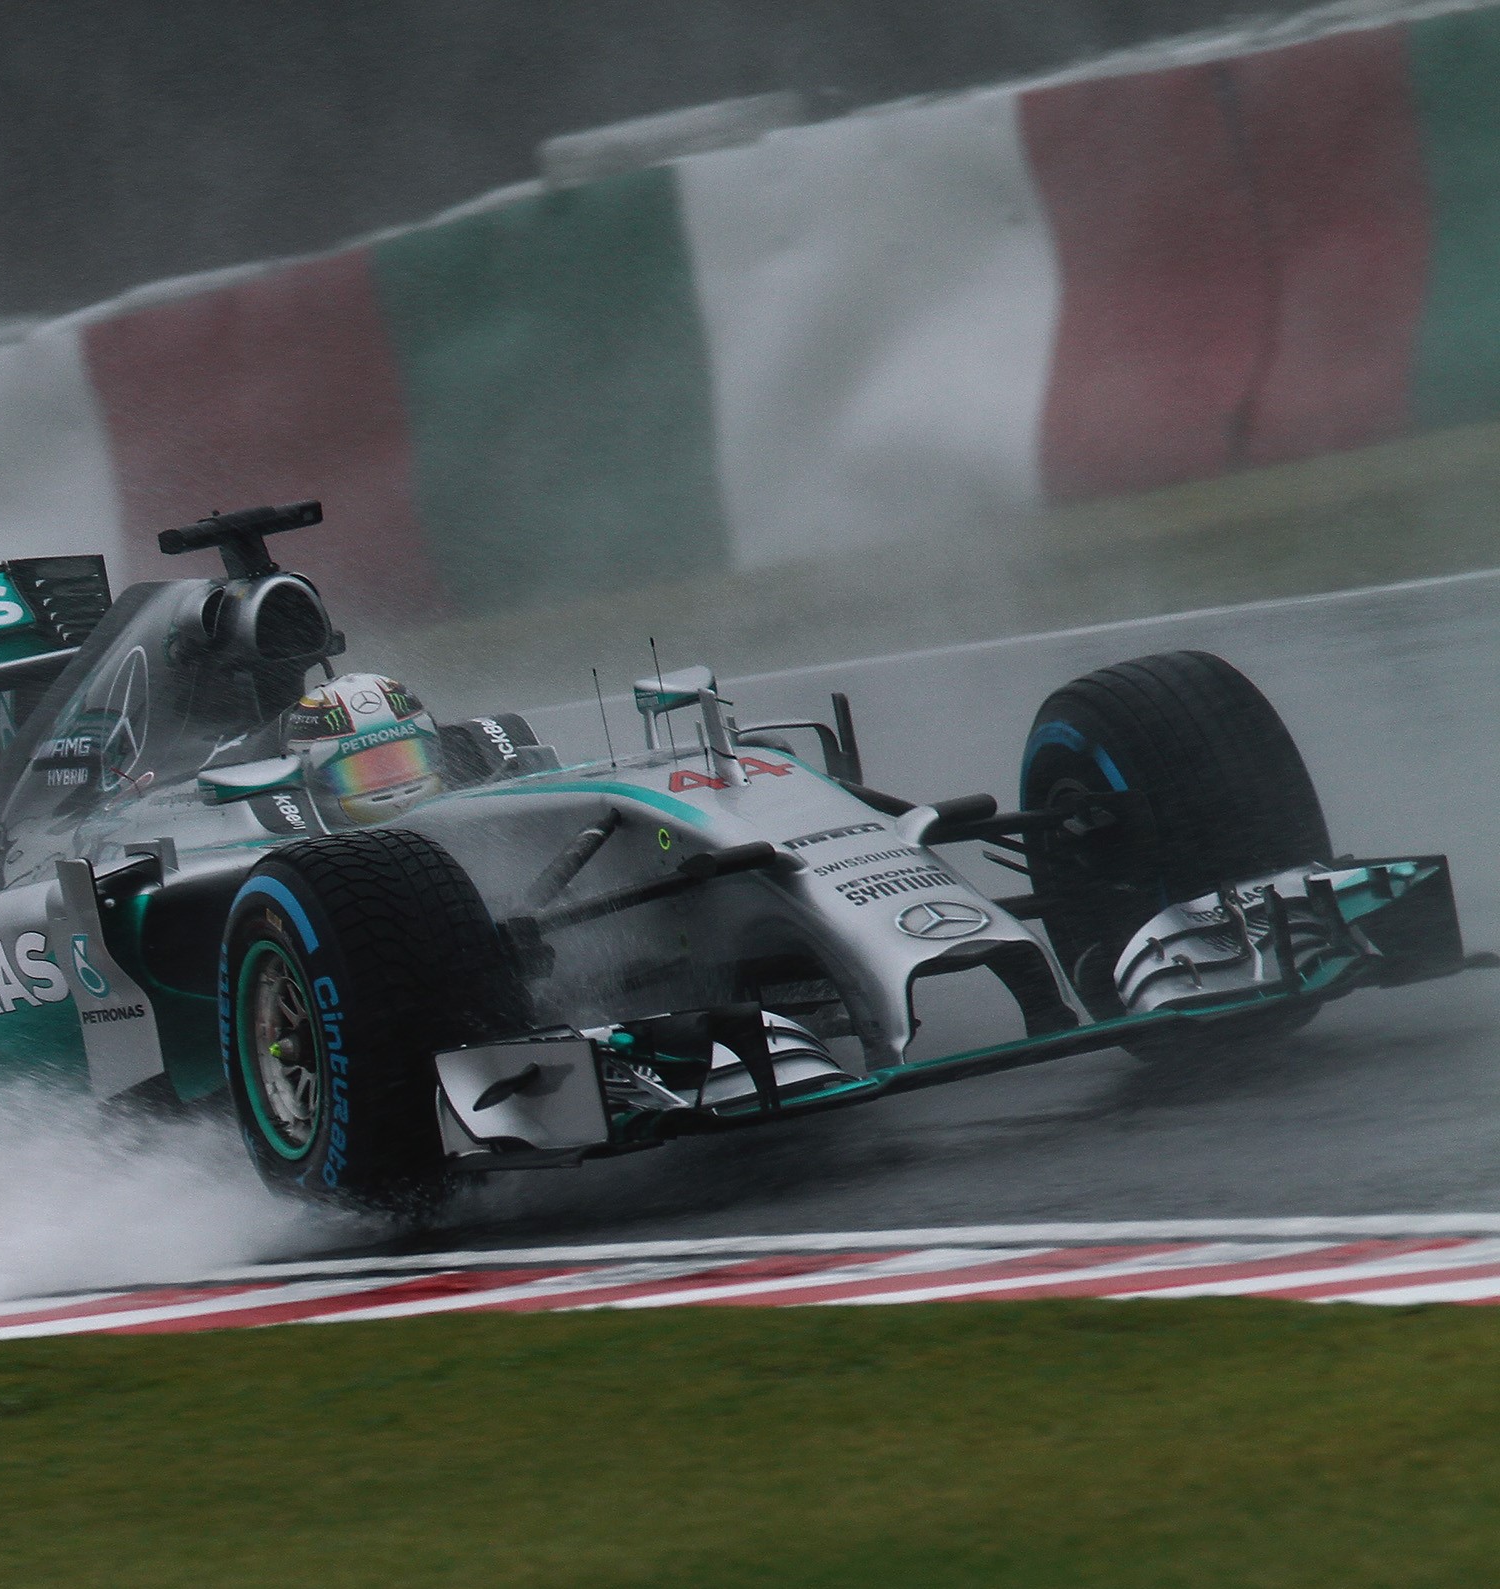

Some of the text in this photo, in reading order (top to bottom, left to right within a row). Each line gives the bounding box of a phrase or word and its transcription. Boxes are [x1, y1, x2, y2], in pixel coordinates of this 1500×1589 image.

[51, 736, 92, 757] AMG
[341, 723, 417, 754] PETRONAS
[47, 767, 89, 786] HYBRID
[668, 756, 797, 793] 44
[835, 864, 940, 893] PETRONAS
[82, 1004, 146, 1025] PETRONAS
